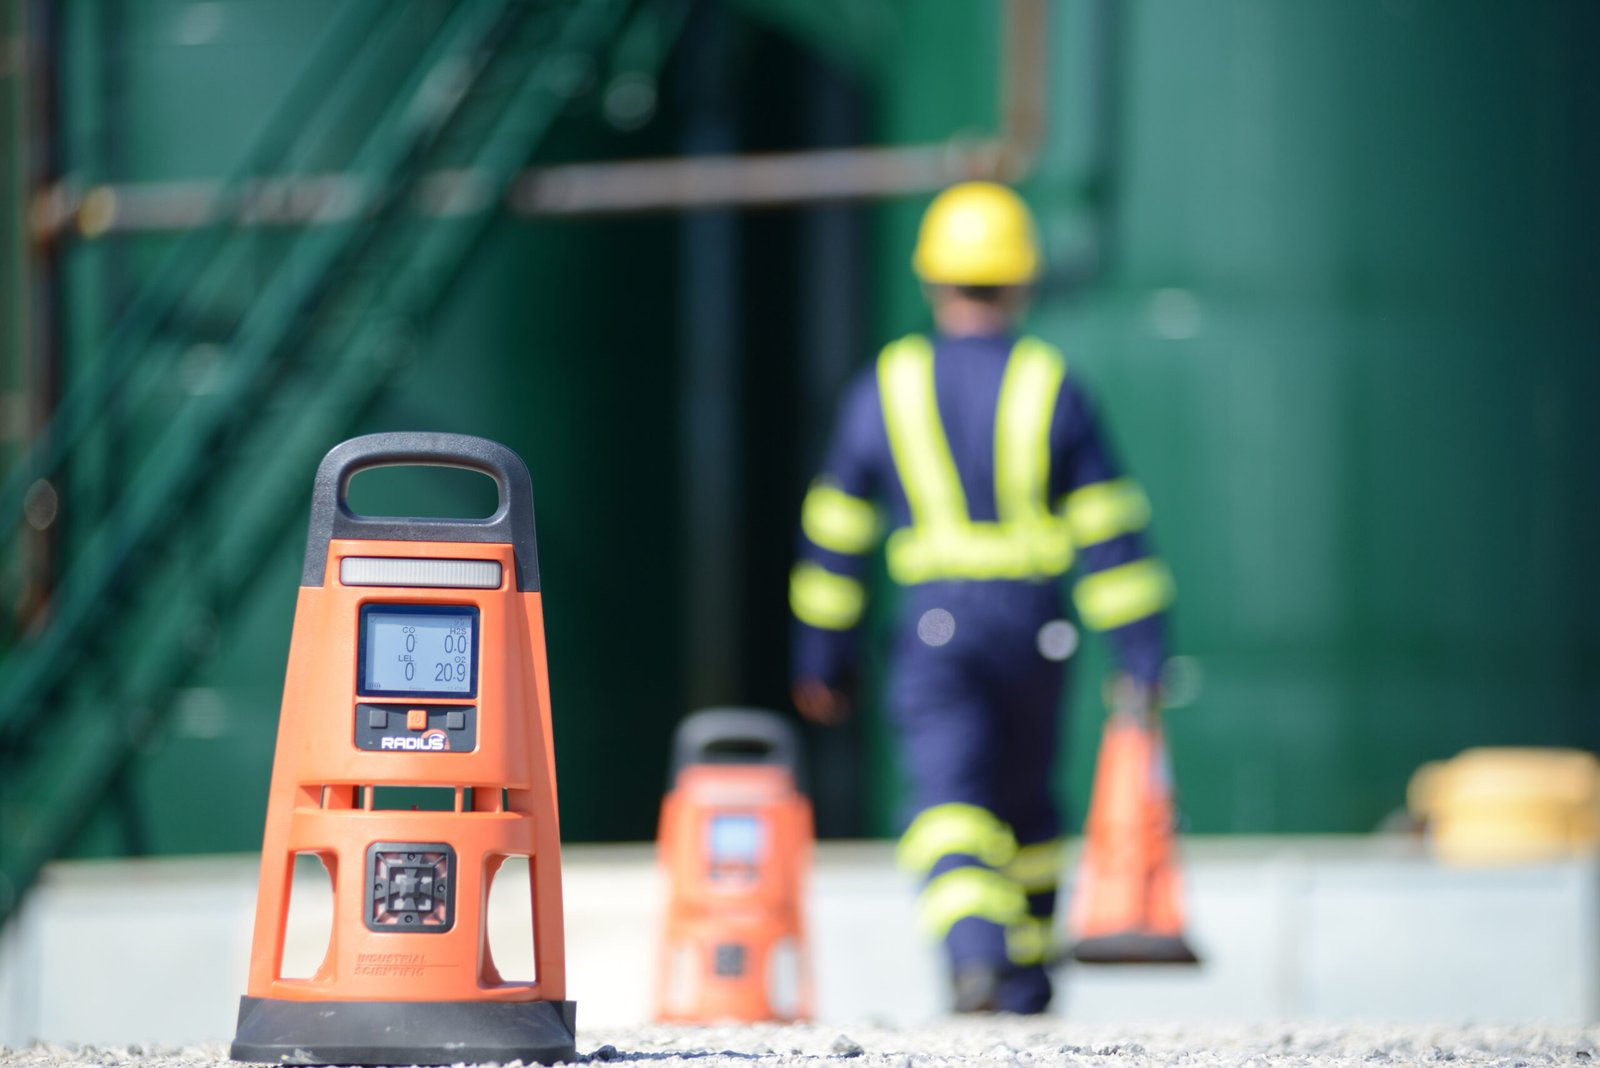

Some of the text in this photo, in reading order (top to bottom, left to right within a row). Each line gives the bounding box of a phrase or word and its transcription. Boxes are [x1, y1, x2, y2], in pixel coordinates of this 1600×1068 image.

[402, 626, 416, 634] CO
[449, 627, 467, 635] H2S
[406, 634, 415, 653] 0
[444, 634, 467, 654] 0.0
[398, 654, 414, 662] LEL
[454, 656, 466, 664] O2
[405, 662, 414, 681] 0
[434, 663, 466, 682] 20.9
[381, 736, 444, 750] RADIUS
[357, 953, 427, 964] INDUSTRIAL
[353, 966, 425, 977] SCIENTIFIC
